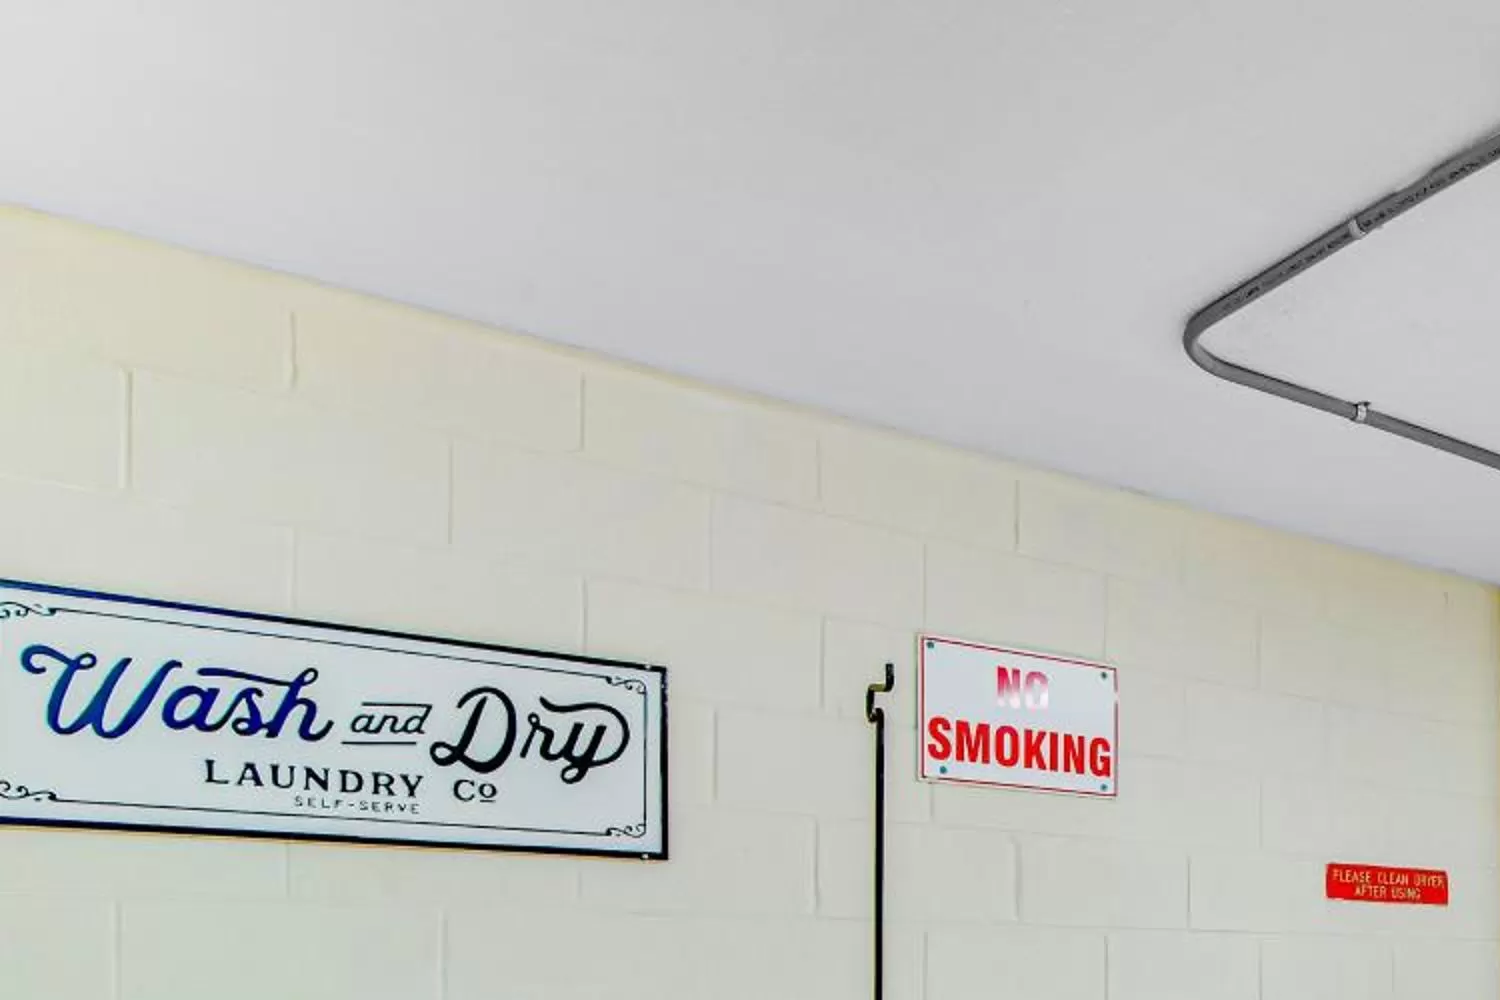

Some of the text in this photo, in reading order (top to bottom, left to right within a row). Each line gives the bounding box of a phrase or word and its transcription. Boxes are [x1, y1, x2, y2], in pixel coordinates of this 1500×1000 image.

[996, 665, 1049, 709] NO
[20, 645, 630, 785] Wash and Dry
[928, 716, 1111, 777] SMOKING
[205, 759, 425, 799] LAUNDRY
[294, 796, 421, 815] SELF-SERVE
[1333, 868, 1371, 883] PLEASE
[1377, 872, 1409, 886] CLEAN
[1354, 885, 1421, 900] AFTER USING
